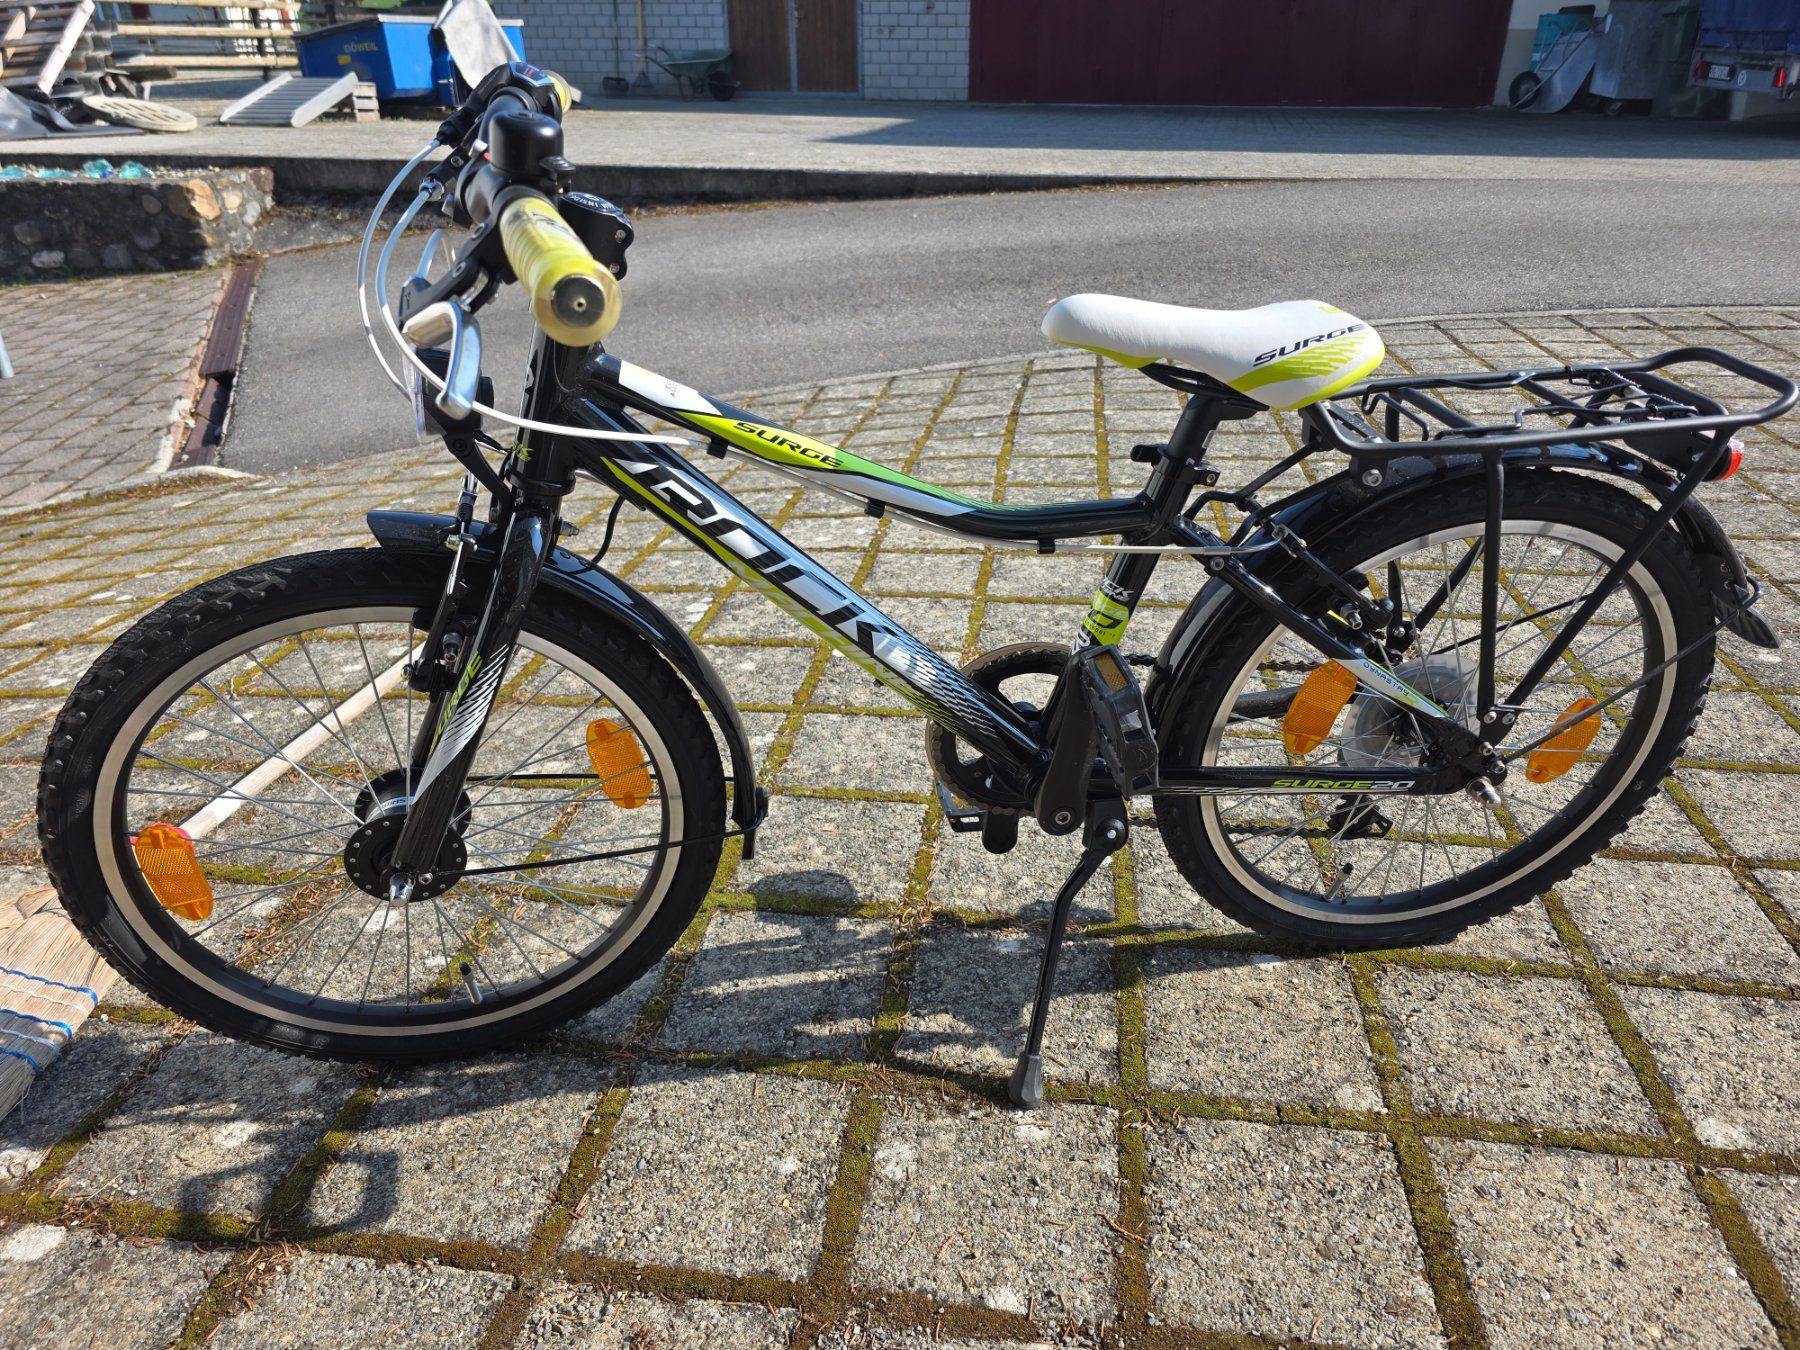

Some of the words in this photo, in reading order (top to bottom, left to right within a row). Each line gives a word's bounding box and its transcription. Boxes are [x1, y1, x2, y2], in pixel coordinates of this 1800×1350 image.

[1253, 324, 1366, 367] SURGE
[733, 421, 844, 467] SURGE
[634, 460, 904, 657] ROCK
[430, 650, 483, 754] SURGE
[1363, 662, 1409, 696] DYNASTAY
